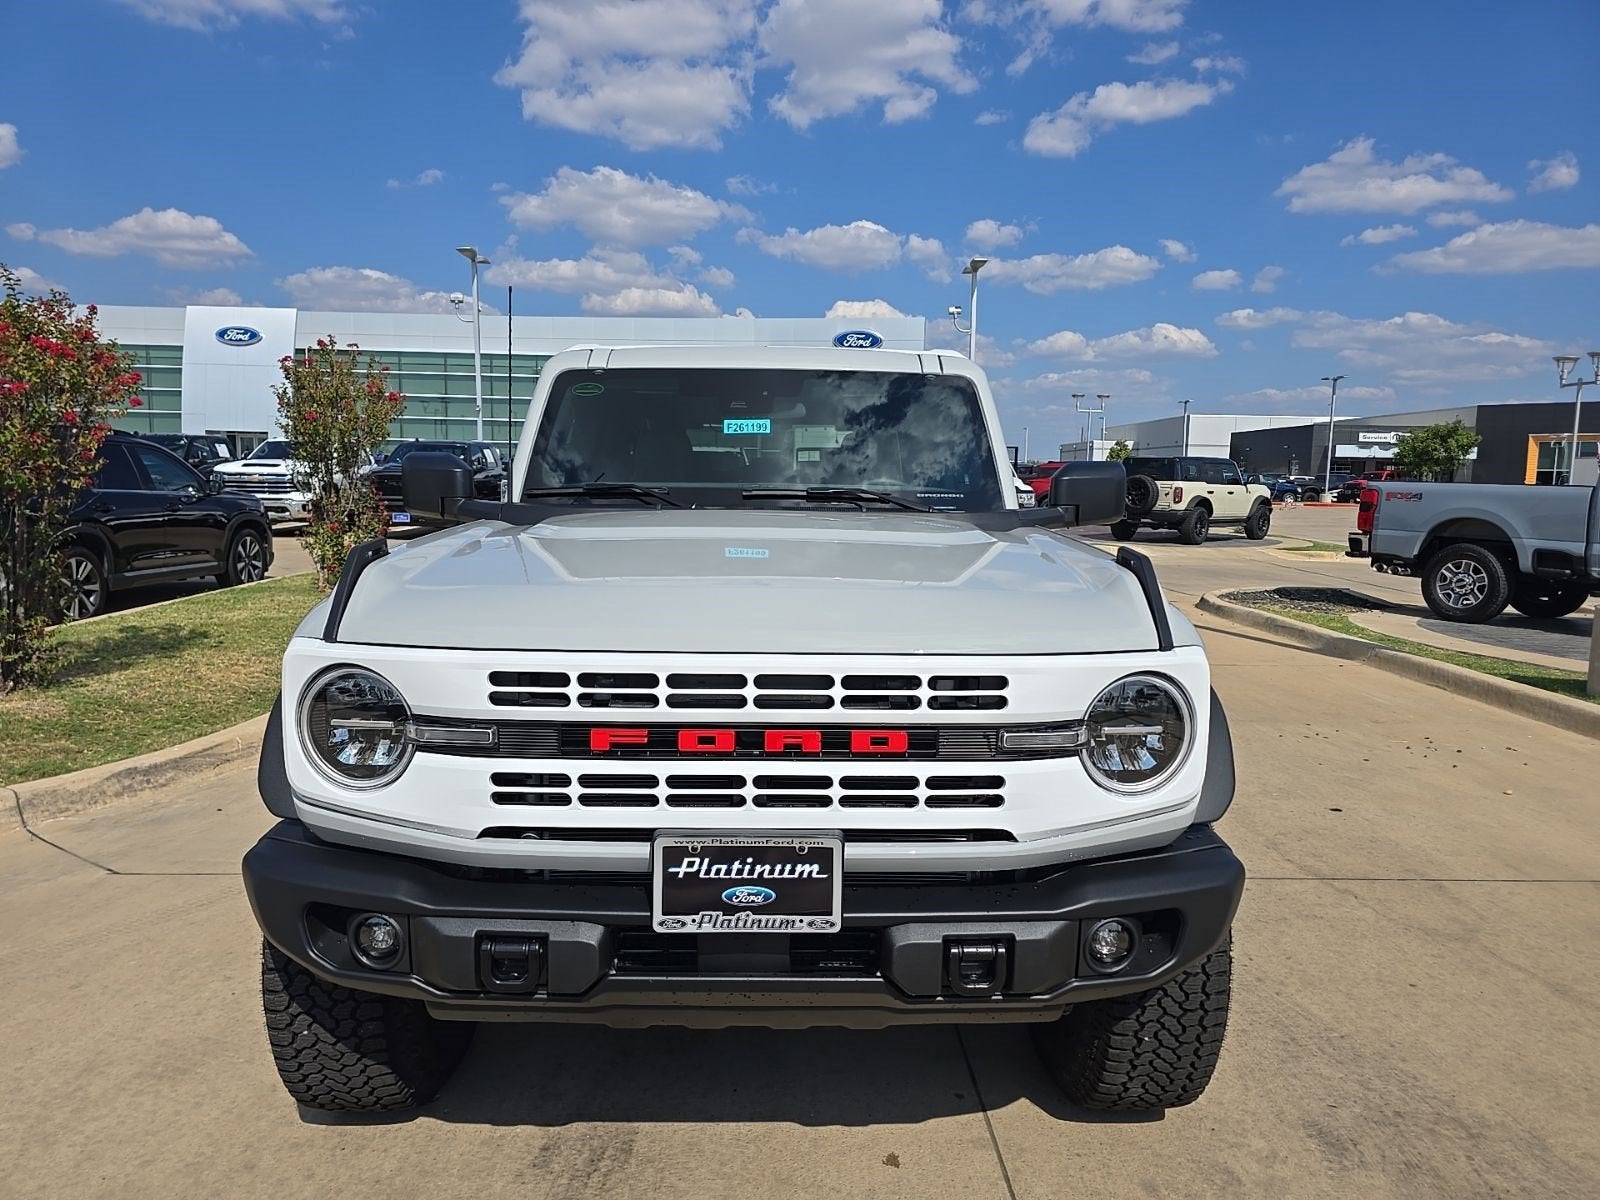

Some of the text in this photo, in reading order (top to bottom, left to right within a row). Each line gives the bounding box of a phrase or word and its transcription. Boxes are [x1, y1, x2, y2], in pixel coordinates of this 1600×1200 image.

[225, 329, 251, 340] Ford
[843, 334, 872, 346] Ford
[727, 423, 767, 432] F261199
[590, 729, 907, 752] FORD
[673, 838, 824, 846] www.PlatinumFord.com
[668, 857, 830, 879] Platinum
[732, 888, 764, 904] Ford
